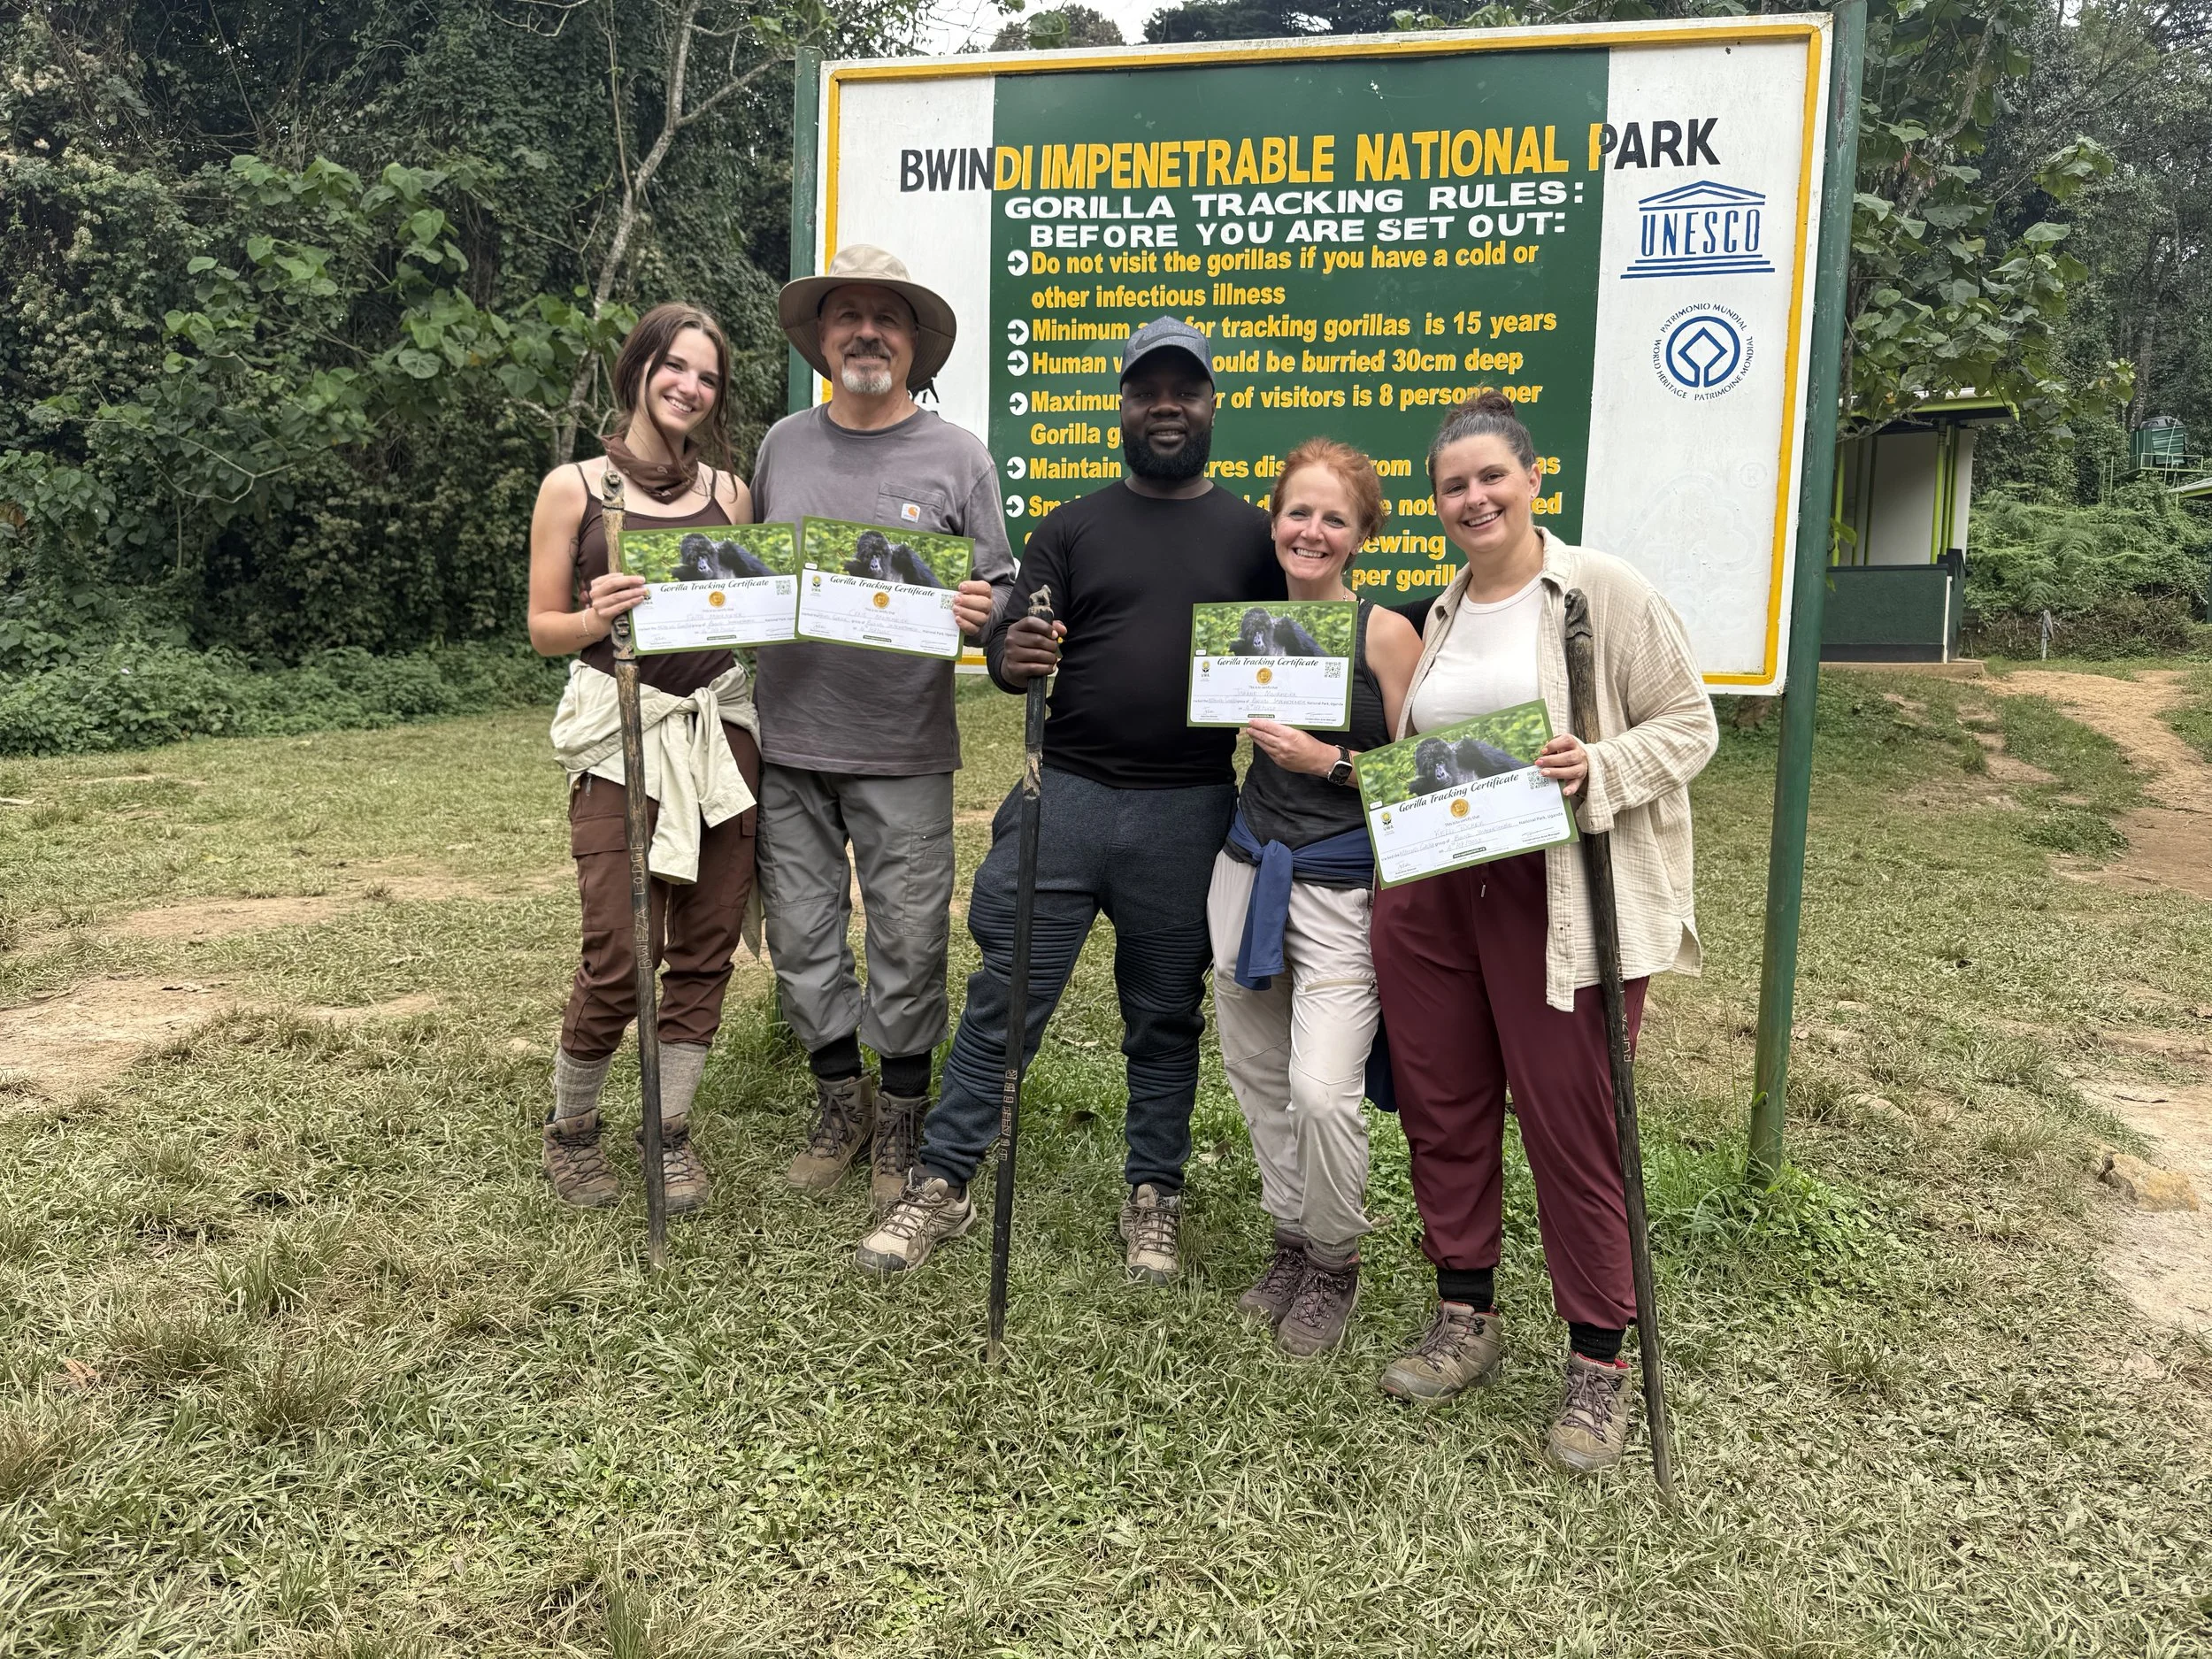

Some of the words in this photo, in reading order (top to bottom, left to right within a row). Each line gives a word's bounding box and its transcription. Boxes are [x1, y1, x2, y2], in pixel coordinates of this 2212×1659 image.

[900, 145, 1033, 192] BWINDI
[1040, 135, 1335, 190] IMPENETRABLE
[1356, 125, 1570, 182] NATIONAL
[1588, 117, 1722, 171] PARK
[1004, 195, 1176, 219] GORILLA
[1191, 188, 1403, 218] TRACKING
[1428, 180, 1584, 211] RULES:
[1030, 224, 1179, 249] BEFORE
[1195, 220, 1275, 246] YOU
[1285, 219, 1365, 243] ARE
[1376, 215, 1455, 242] SET
[1468, 211, 1566, 239] OUT:
[1641, 210, 1761, 257] UNESCO
[1031, 250, 1061, 275] Do
[1066, 251, 1104, 274] not
[1109, 250, 1158, 273] visit
[1163, 250, 1202, 273] the
[1207, 248, 1292, 278] gorillas
[1300, 245, 1317, 269] if
[1322, 250, 1365, 274] you
[1371, 244, 1427, 268] have
[1432, 249, 1448, 266] a
[1455, 240, 1507, 266] cold
[1512, 243, 1539, 264] or
[1031, 285, 1089, 309] other
[1095, 283, 1207, 308] infectious
[1212, 282, 1286, 306] illness
[1032, 318, 1130, 342] Minimum
[1221, 313, 1317, 343] tracking
[1323, 312, 1411, 343] gorillas
[1425, 312, 1445, 335] is
[1453, 311, 1483, 334] 15
[1490, 312, 1557, 339] years
[1660, 303, 1710, 333] PATRIMONIO
[1713, 303, 1747, 332] MUNDIAL
[1032, 351, 1107, 374] Human
[1211, 349, 1260, 373] ould
[1265, 349, 1295, 373] be
[1302, 349, 1386, 373] burried
[1392, 348, 1456, 372] 30cm
[1464, 347, 1524, 375] deep
[1653, 339, 1662, 370] WORLD
[1694, 375, 1743, 401] PATRIMOINE
[1740, 336, 1754, 376] MONDIAL
[1031, 390, 1122, 411] Maximu
[1231, 385, 1254, 409] of
[1260, 385, 1345, 408] visitors
[1352, 384, 1371, 407] is
[1379, 382, 1394, 407] 8
[1502, 385, 1543, 403] per
[1656, 370, 1688, 399] HERITAGE
[1030, 422, 1101, 445] Gorilla
[1029, 457, 1122, 480] Maintain
[1367, 458, 1411, 477] rom
[1358, 529, 1446, 560] ewing
[660, 582, 688, 593] Gorilla
[691, 581, 726, 592] Tracking
[728, 579, 769, 589] Certificate
[830, 575, 856, 586] Gorilla
[858, 580, 892, 592] Tracking
[895, 584, 935, 597] Certificate
[1351, 568, 1391, 591] per
[1396, 564, 1456, 592] gorill
[1217, 657, 1240, 666] Gorilla
[1243, 657, 1275, 668] Tracking
[1277, 657, 1319, 668] Certificate
[1399, 798, 1427, 812] Gorilla
[1430, 787, 1468, 804] Tracking
[1470, 772, 1519, 792] Certificate
